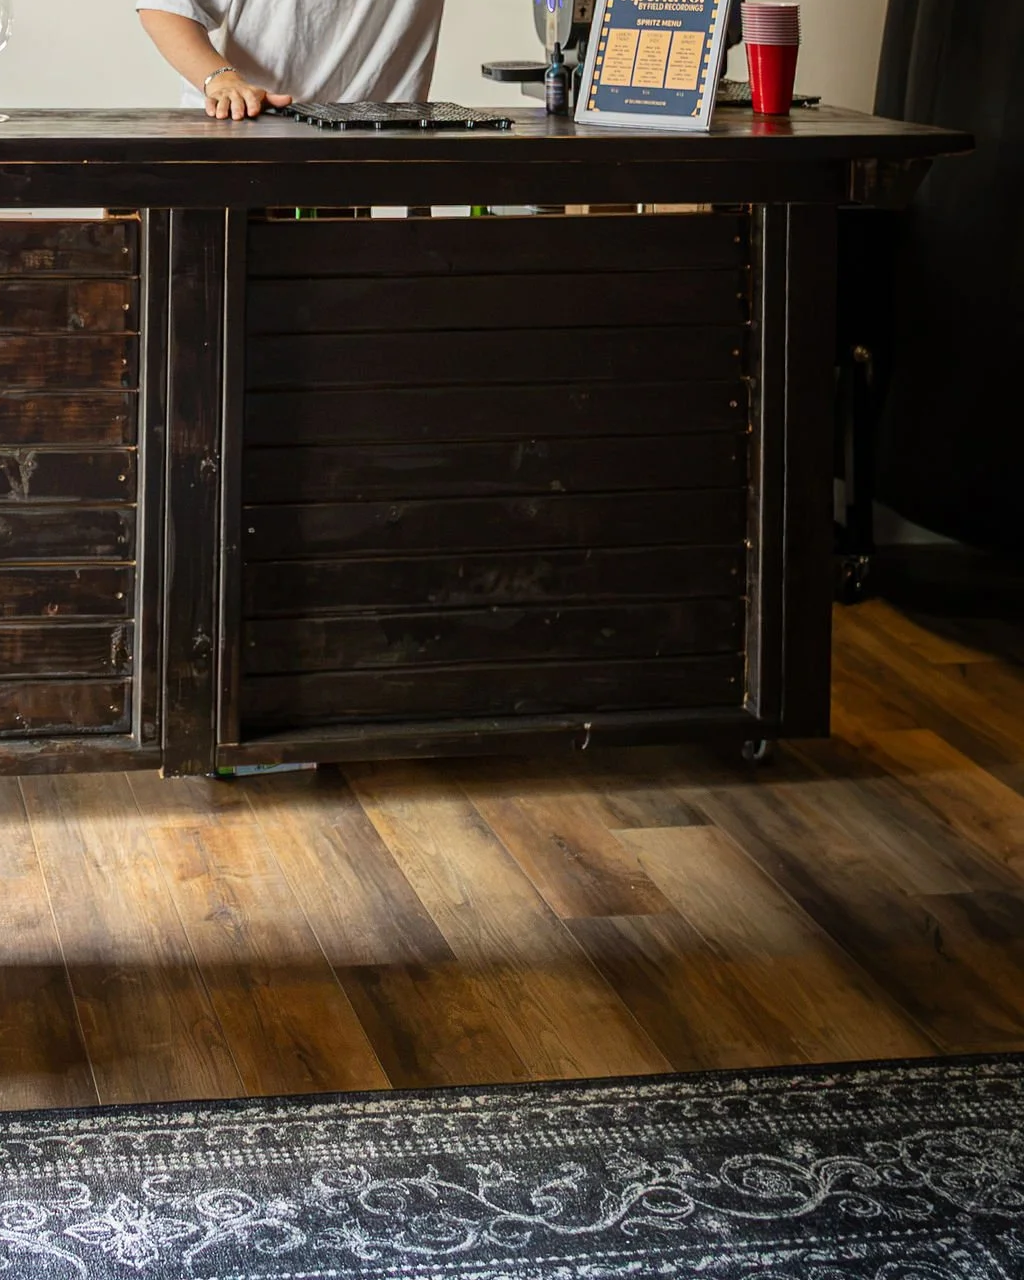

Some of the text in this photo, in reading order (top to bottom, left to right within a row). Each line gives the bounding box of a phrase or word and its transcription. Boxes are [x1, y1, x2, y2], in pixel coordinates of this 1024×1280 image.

[638, 2, 704, 12] BY FIELD RECORDINGS
[636, 18, 682, 27] SPRITZ MENU
